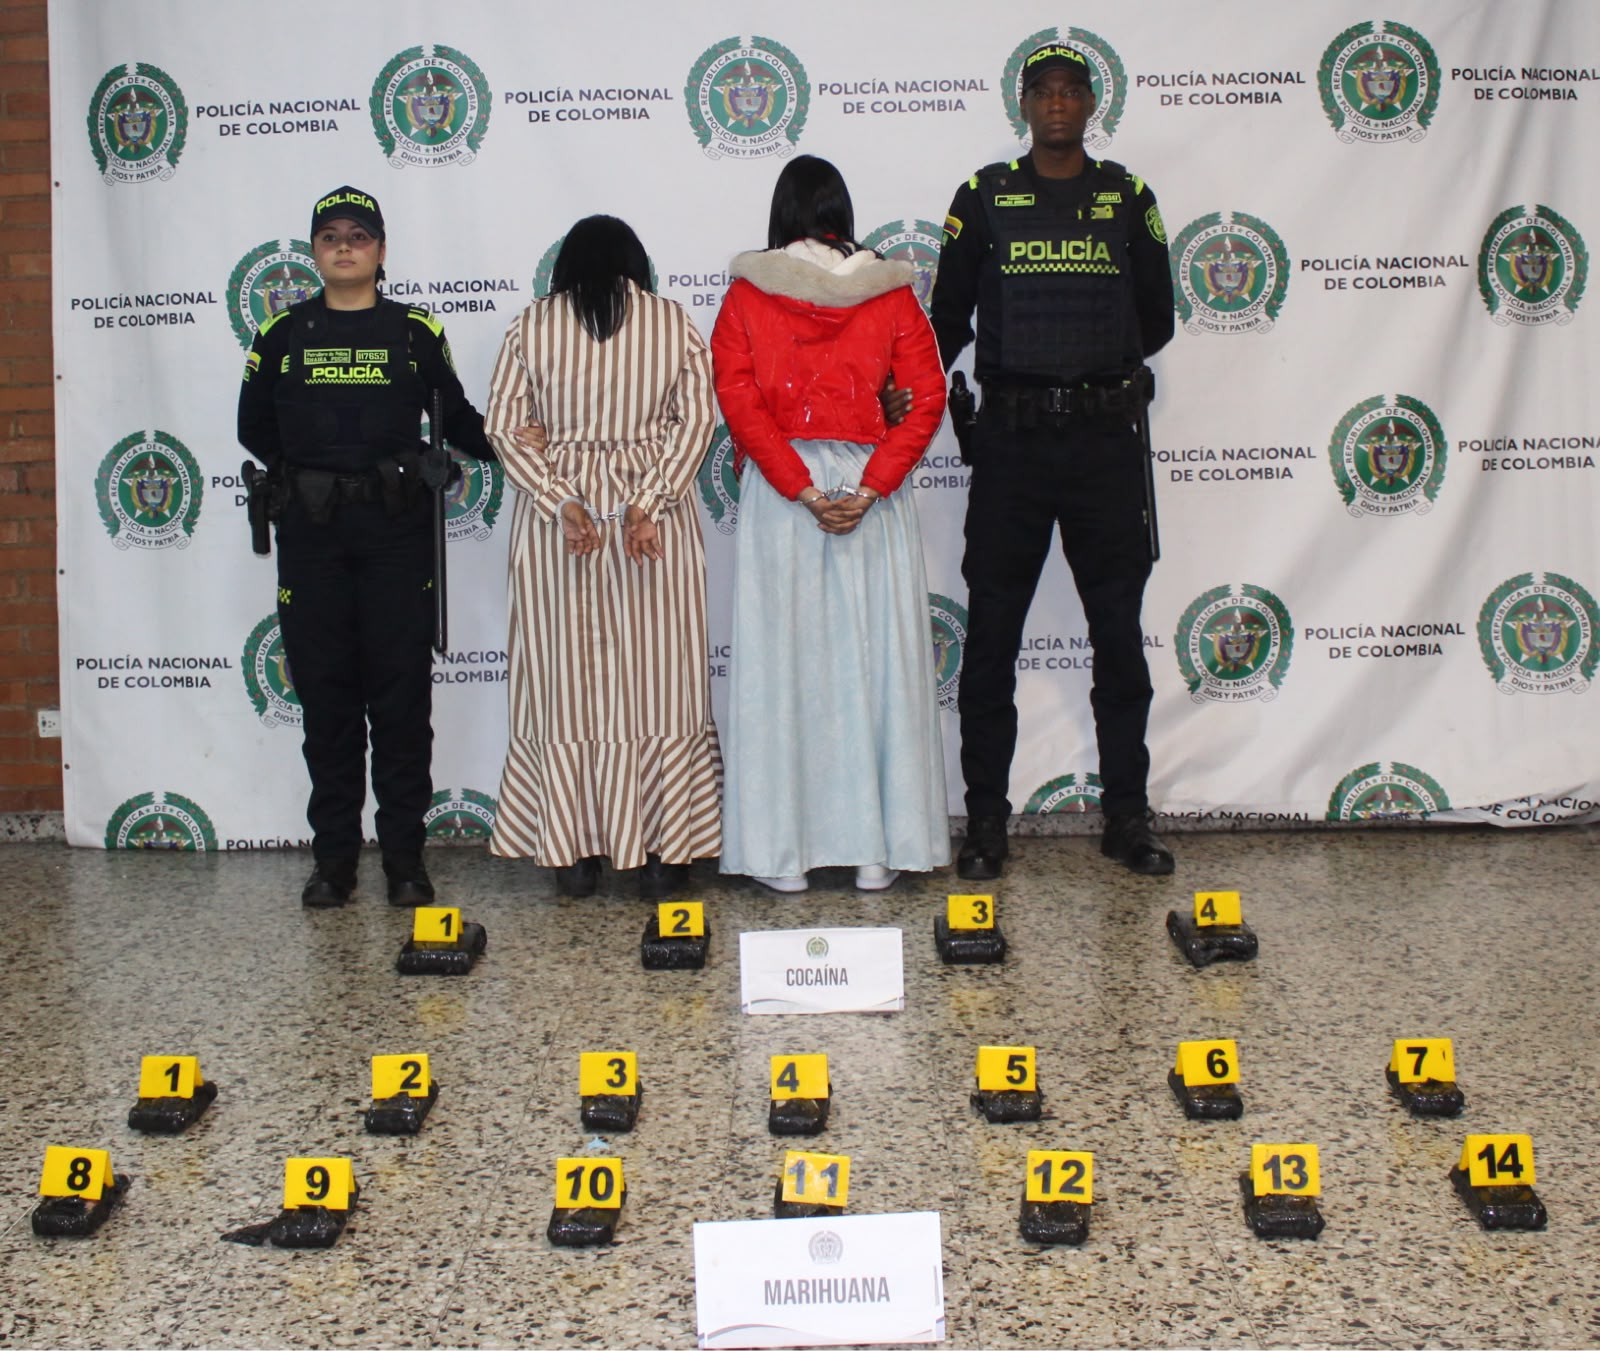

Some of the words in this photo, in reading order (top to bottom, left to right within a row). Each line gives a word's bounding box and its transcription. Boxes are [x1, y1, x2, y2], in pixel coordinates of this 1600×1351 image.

[1373, 34, 1387, 42] DE
[1397, 39, 1426, 88] COLOMBIA
[765, 54, 795, 103] COLOMBIA
[1136, 70, 1207, 88] POLICÍA
[1212, 71, 1306, 86] NACIONAL
[1451, 65, 1517, 82] POLICÍA
[1521, 67, 1600, 82] NACIONAL
[446, 63, 476, 111] COLOMBIA
[504, 89, 574, 104] POLICÍA
[578, 88, 674, 102] NACIONAL
[818, 79, 890, 96] POLICÍA
[894, 78, 990, 94] NACIONAL
[1474, 87, 1494, 101] DE
[1498, 87, 1578, 101] COLOMBIA
[196, 103, 265, 119] POLICÍA
[269, 98, 361, 115] NACIONAL
[843, 101, 866, 115] DE
[870, 98, 966, 114] COLOMBIA
[1160, 93, 1183, 106] DE
[1188, 91, 1283, 105] COLOMBIA
[528, 109, 551, 123] DE
[555, 107, 650, 122] COLOMBIA
[1381, 99, 1422, 128] NACIONAL
[219, 123, 241, 137] DE
[246, 119, 339, 136] COLOMBIA
[432, 122, 473, 153] NACIONAL
[749, 114, 792, 144] NACIONAL
[1381, 126, 1413, 140] PATRIA
[432, 149, 463, 165] PATRIA
[749, 141, 782, 156] PATRIA
[1010, 234, 1111, 262] POLICÍA
[1221, 225, 1235, 233] DE
[1245, 230, 1275, 279] COLOMBIA
[1301, 257, 1371, 272] POLICÍA
[1376, 255, 1470, 270] NACIONAL
[380, 279, 423, 296] LICÍA
[428, 279, 519, 294] NACIONAL
[669, 270, 733, 287] POLICÍ
[1324, 277, 1348, 291] DE
[1352, 275, 1446, 290] COLOMBIA
[71, 293, 133, 311] POLICÍA
[134, 291, 218, 308] NACIONAL
[407, 299, 497, 314] OLOMBIA
[692, 294, 716, 307] DE
[1229, 290, 1271, 320] NACIONAL
[94, 316, 114, 329] DE
[118, 311, 196, 328] COLOMBIA
[1229, 317, 1262, 332] PATRIA
[312, 363, 384, 379] POLICÍA
[1385, 408, 1399, 416] DE
[1407, 413, 1433, 461] COLOMBIA
[1458, 435, 1519, 453] POLICÍA
[1222, 446, 1317, 461] NACIONAL
[1481, 458, 1502, 472] DE
[1502, 455, 1595, 471] COLOMBIA
[164, 448, 190, 496] COLOMBIA
[1170, 469, 1193, 483] DE
[1198, 466, 1294, 482] COLOMBIA
[1389, 472, 1429, 501] NACIONAL
[447, 497, 488, 528] NACIONAL
[1388, 498, 1420, 513] PATRIA
[155, 507, 187, 535] NACIONAL
[447, 524, 479, 539] PATRIA
[154, 532, 180, 546] PATRIA
[1533, 586, 1547, 594] DE
[1557, 591, 1590, 639] COLOMBIA
[1304, 626, 1377, 641] POLICÍA
[1381, 622, 1465, 638] NACIONAL
[1329, 646, 1352, 660] DE
[1357, 642, 1443, 658] COLOMBIA
[76, 657, 143, 671] POLICÍA
[148, 657, 233, 670] NACIONAL
[1018, 658, 1041, 670] DE
[1543, 650, 1586, 679] NACIONAL
[97, 676, 120, 689] DE
[124, 675, 212, 689] COLOMBIA
[1544, 677, 1576, 691] PATRIA
[973, 901, 988, 924] 3
[1201, 899, 1217, 921] 4
[439, 913, 452, 937] 1
[672, 910, 690, 933] 2
[786, 963, 849, 987] COCAÍNA
[1006, 1055, 1027, 1084] 5
[1206, 1049, 1229, 1079] 6
[1406, 1047, 1428, 1076] 7
[164, 1063, 181, 1092] 1
[400, 1061, 421, 1090] 2
[606, 1059, 627, 1089] 3
[776, 1062, 800, 1093] 4
[1477, 1142, 1524, 1180] 14
[67, 1157, 91, 1192] 8
[787, 1159, 840, 1198] 11
[1033, 1159, 1086, 1195] 12
[1263, 1154, 1309, 1190] 13
[305, 1165, 331, 1201] 9
[566, 1166, 614, 1202] 10
[764, 1276, 891, 1306] MARIHUANA
